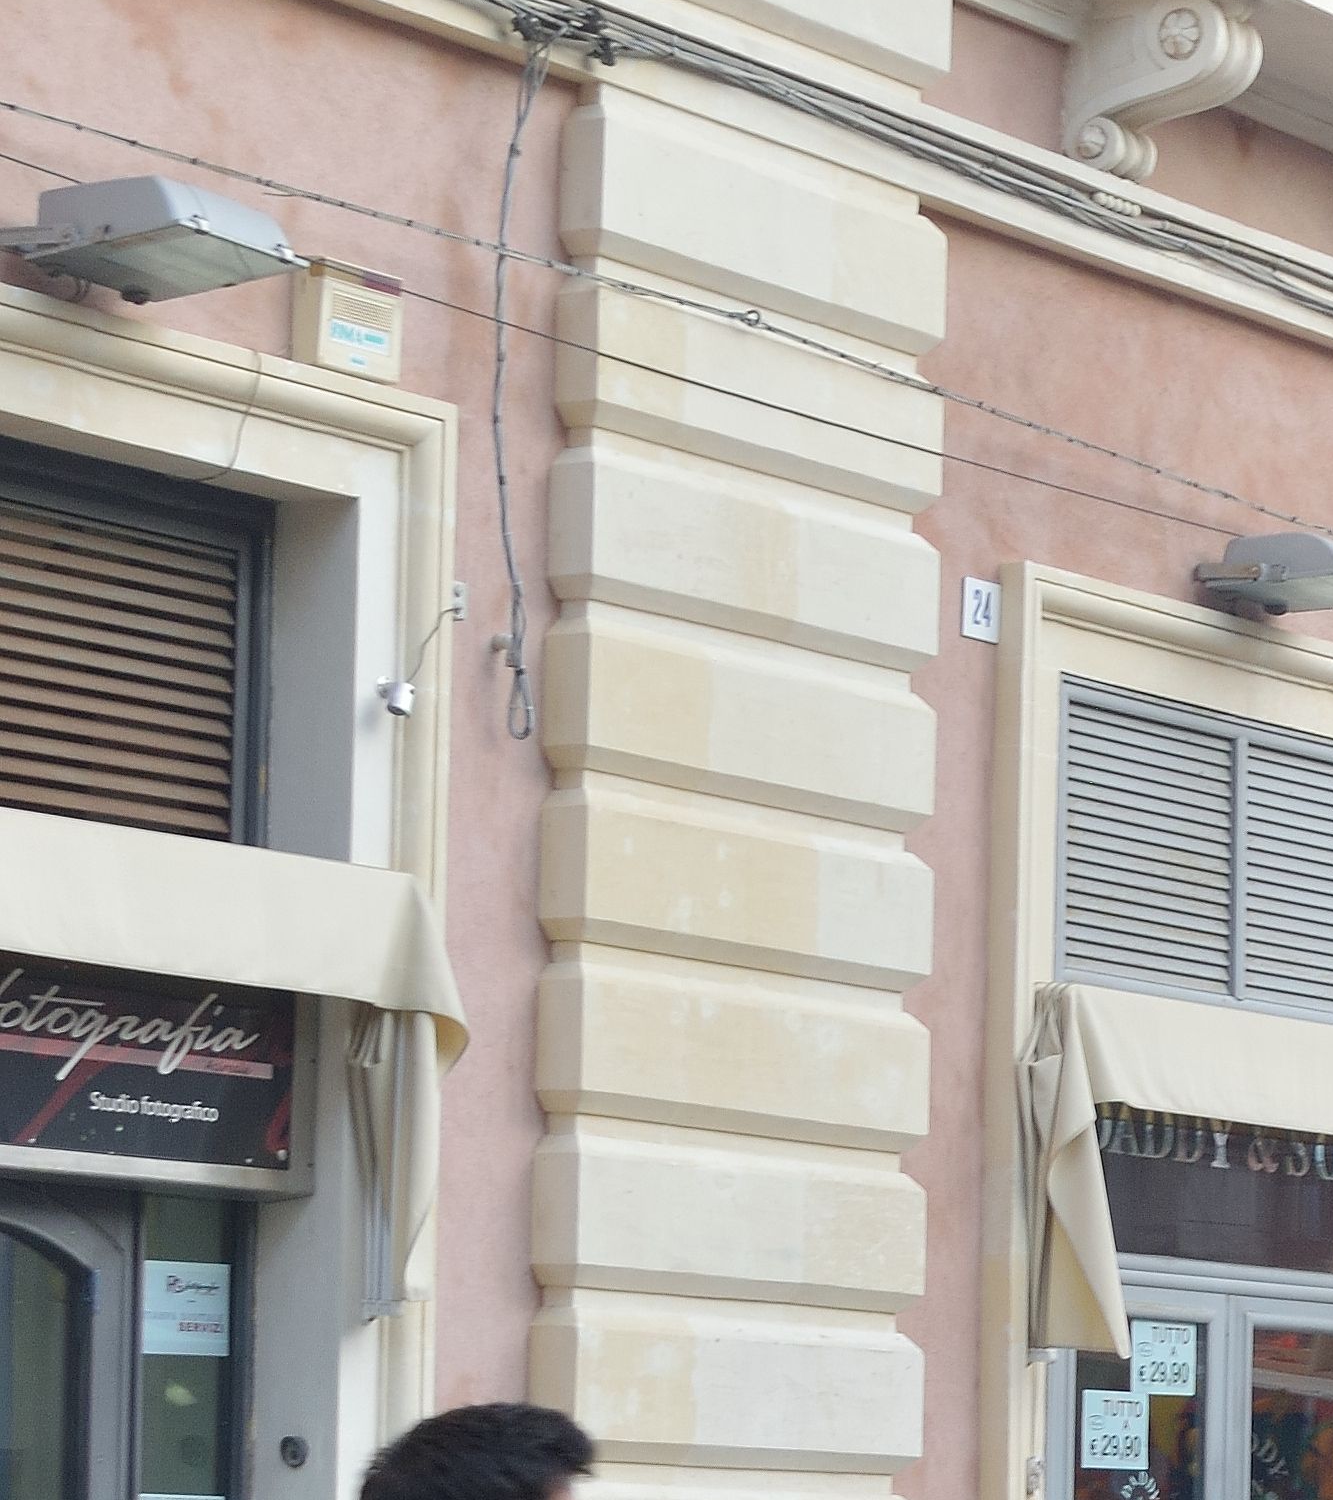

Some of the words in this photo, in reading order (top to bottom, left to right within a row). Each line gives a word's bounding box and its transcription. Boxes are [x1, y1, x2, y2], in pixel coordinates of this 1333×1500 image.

[972, 588, 992, 628] 24
[90, 1091, 140, 1114] Studio
[1151, 1326, 1190, 1345] TUTTO
[1103, 1399, 1143, 1418] TUTTO
